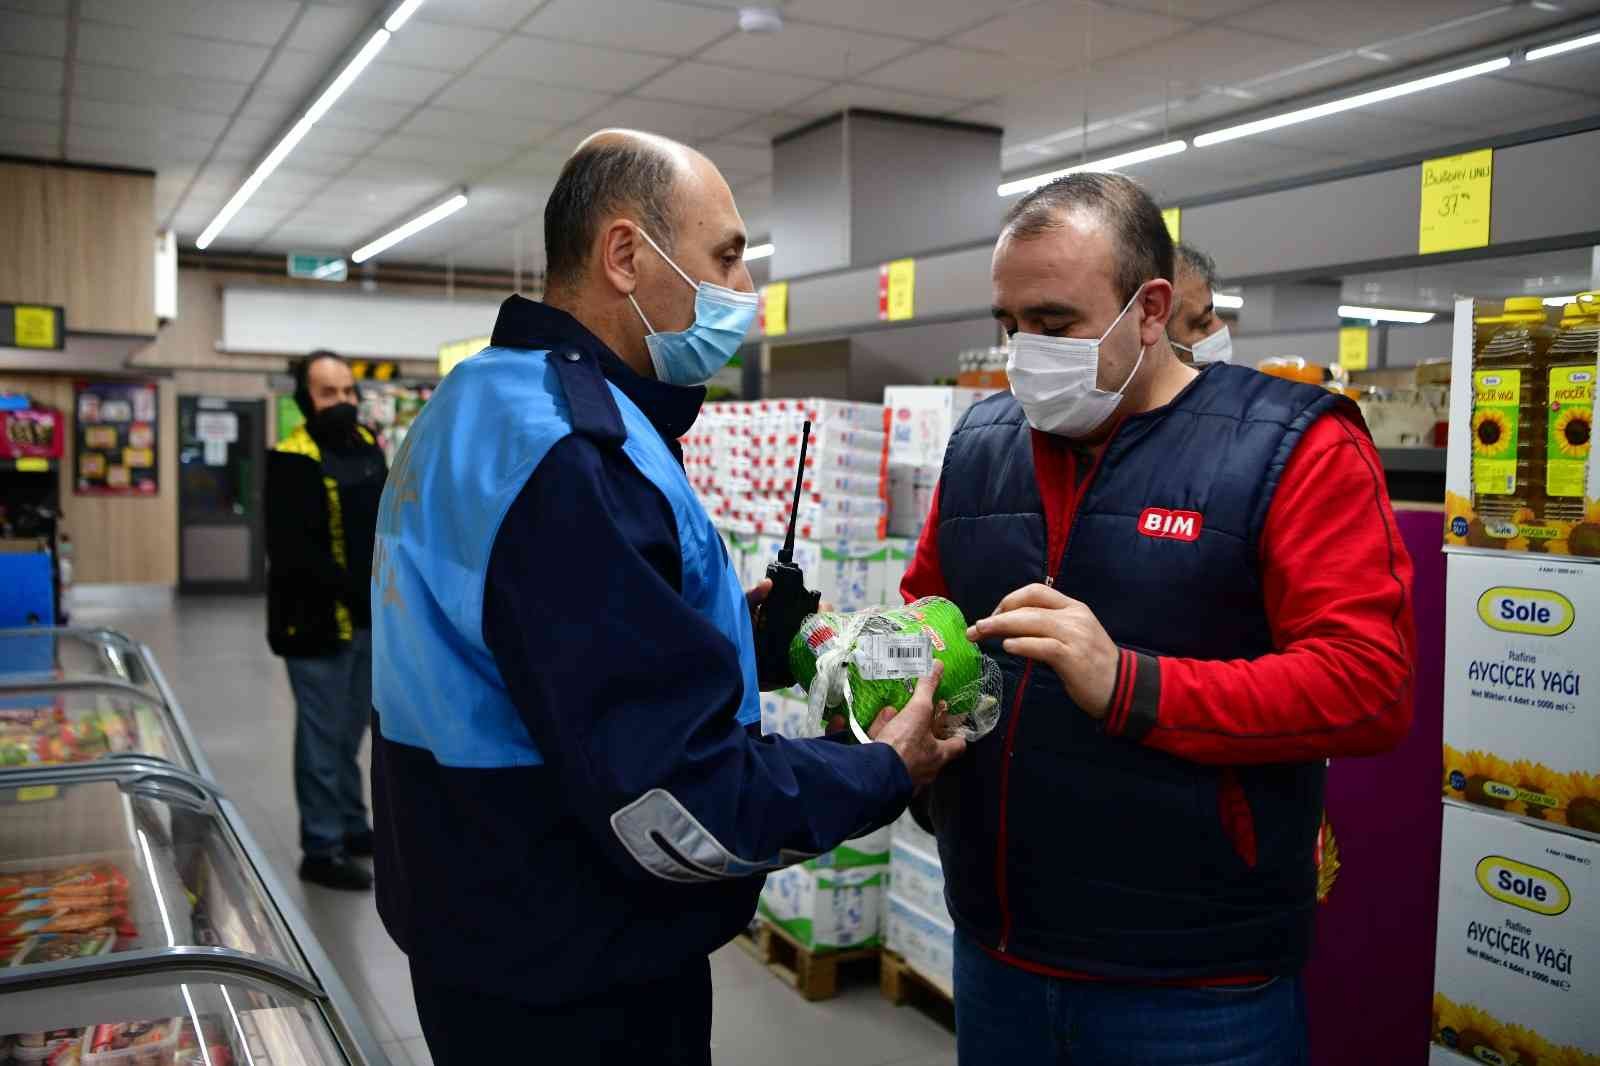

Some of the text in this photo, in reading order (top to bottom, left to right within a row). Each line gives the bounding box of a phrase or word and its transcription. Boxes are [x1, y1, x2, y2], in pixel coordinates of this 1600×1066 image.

[1500, 598, 1551, 624] Sole
[1508, 650, 1537, 664] Rafine
[1468, 660, 1580, 696] AYÇİÇEK YAĞI
[1497, 869, 1547, 902] Sole
[1505, 919, 1532, 935] Rafine
[1467, 921, 1572, 975] AYÇİÇEK YAĞI
